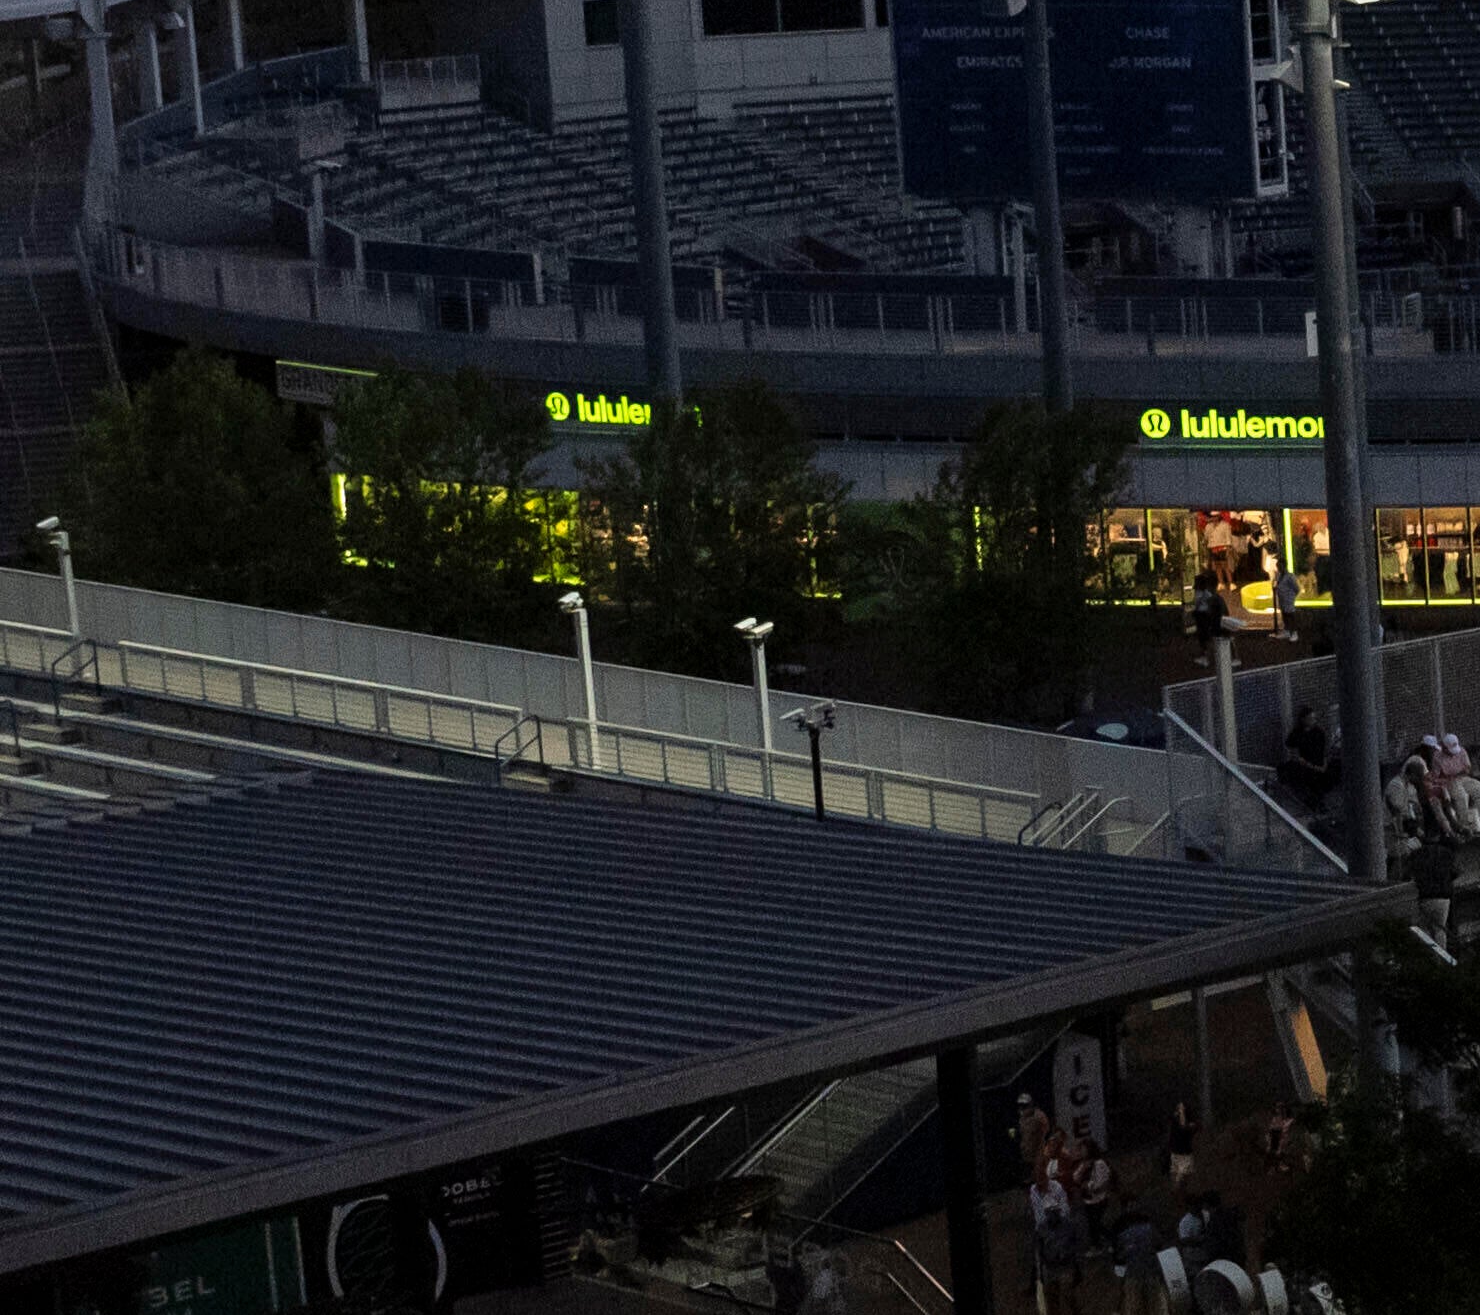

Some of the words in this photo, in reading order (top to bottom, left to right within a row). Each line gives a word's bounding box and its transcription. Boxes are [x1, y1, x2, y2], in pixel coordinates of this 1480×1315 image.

[922, 26, 991, 38] AMERICAN
[1125, 27, 1170, 39] CHASE
[956, 56, 1023, 69] EMIRATES
[1134, 56, 1192, 69] MORGAN
[1181, 408, 1325, 439] lululemo
